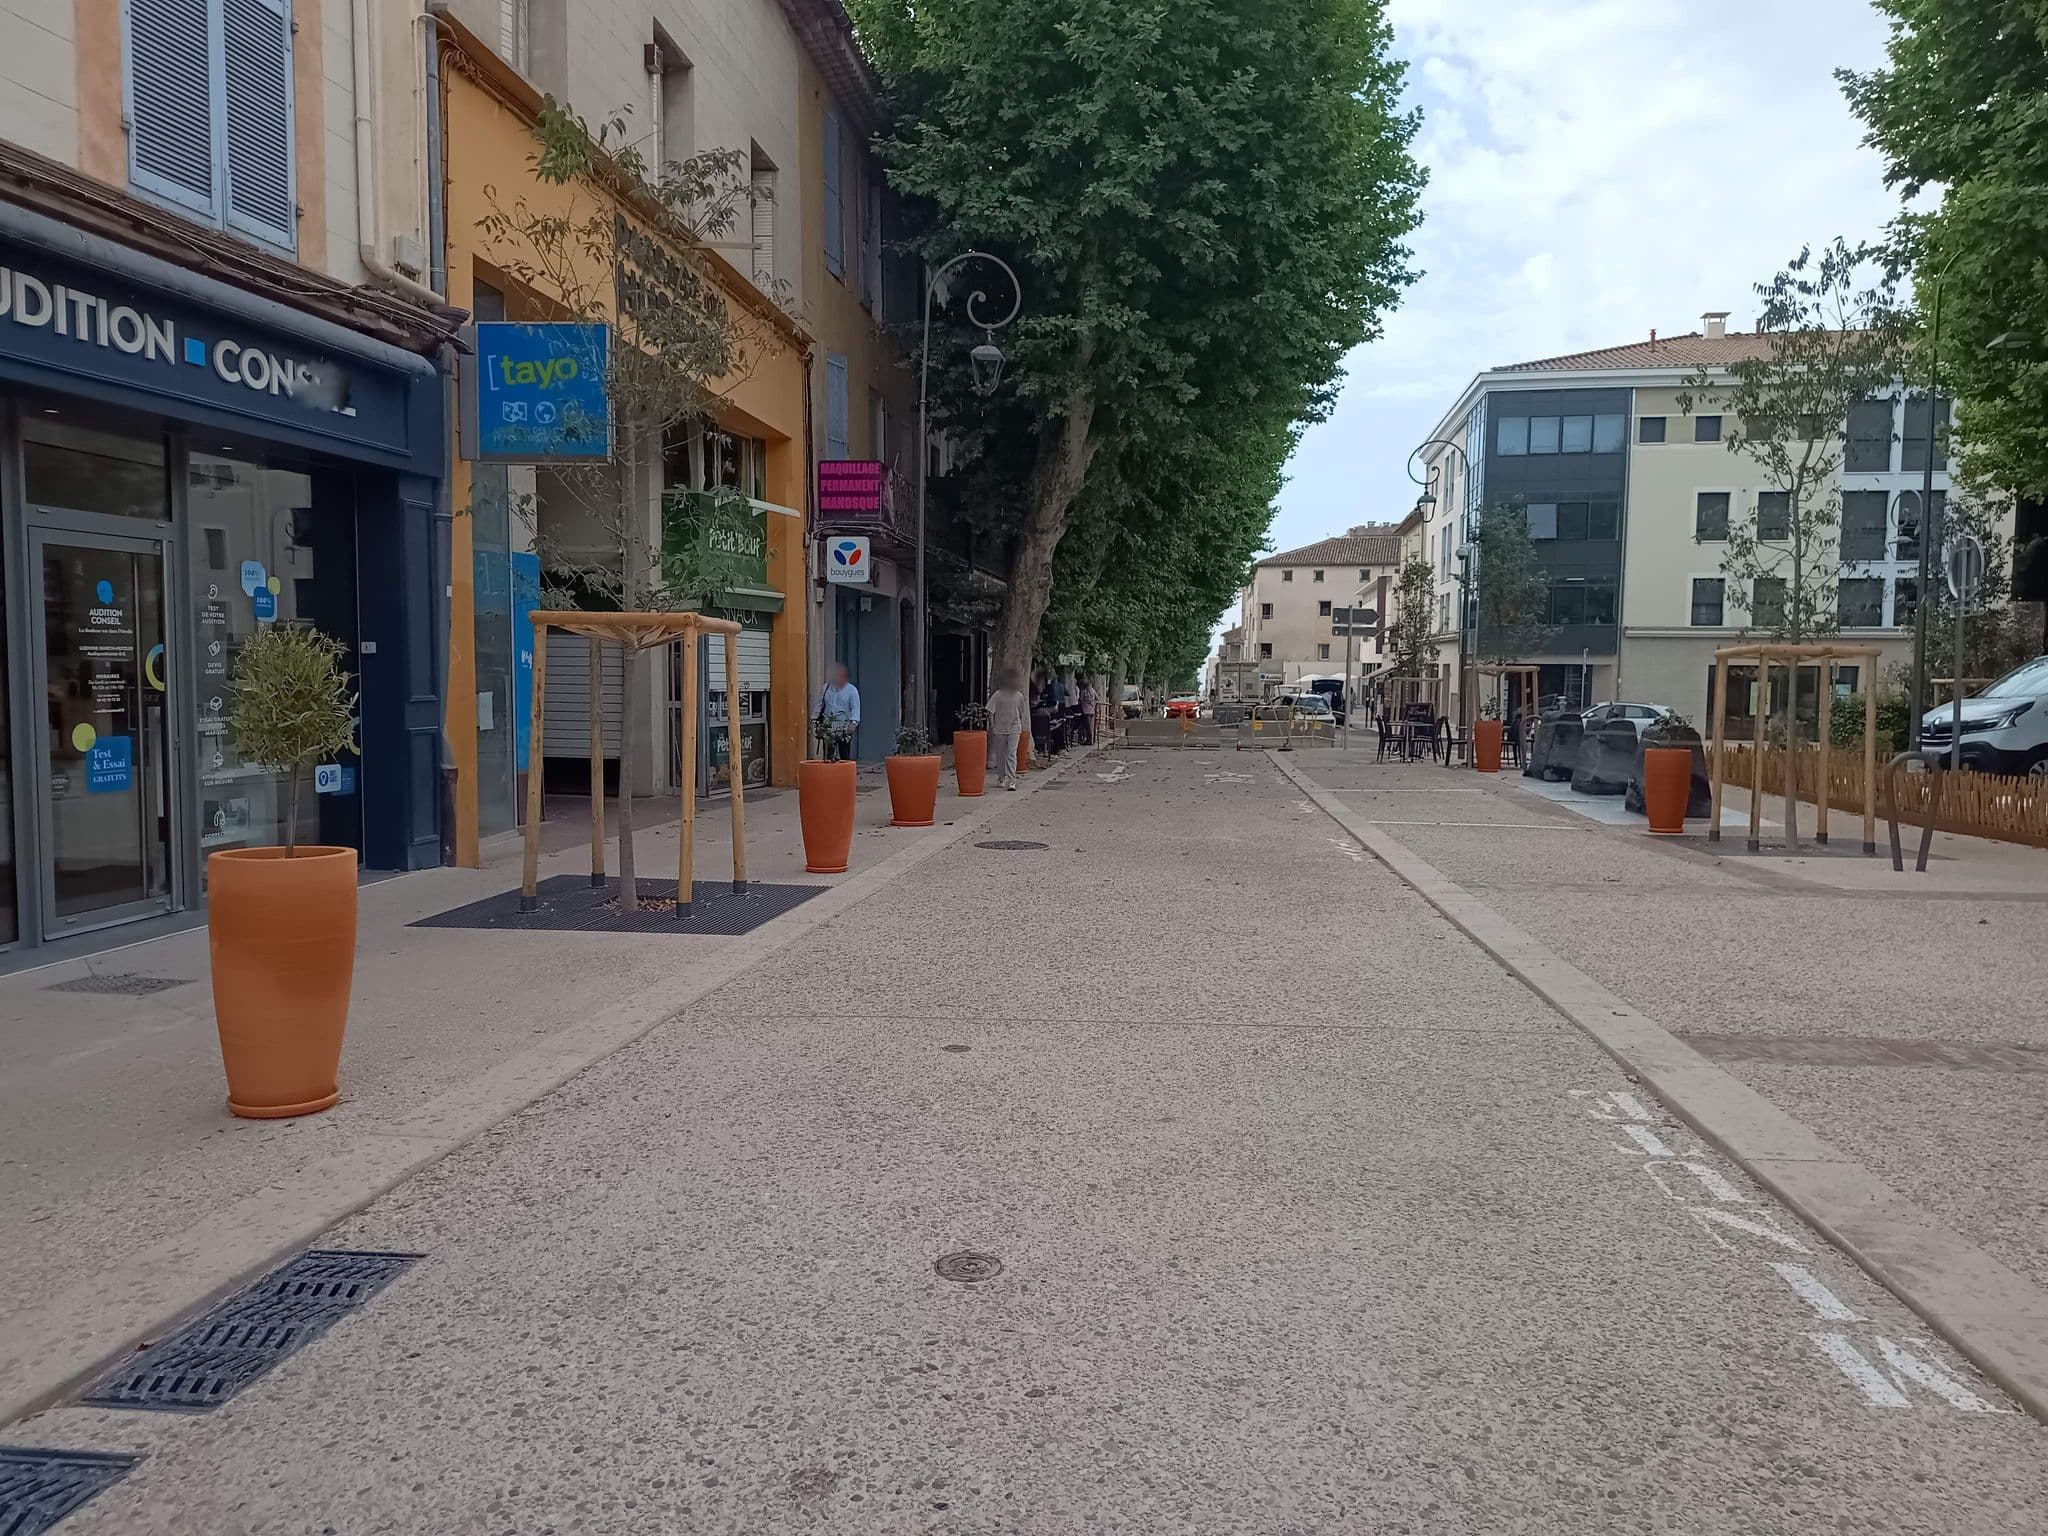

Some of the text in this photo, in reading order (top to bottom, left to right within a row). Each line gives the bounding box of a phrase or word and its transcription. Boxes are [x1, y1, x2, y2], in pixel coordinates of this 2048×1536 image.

[500, 354, 578, 391] tayo
[820, 462, 880, 475] MAQUILLAGE
[820, 480, 880, 492] PERMANENT
[820, 496, 880, 510] MANOSQUE
[830, 567, 865, 578] bouygues
[89, 607, 123, 618] AUDITION
[90, 616, 122, 626] CONSEIL
[92, 749, 112, 759] Test
[103, 758, 126, 769] Essai
[93, 773, 127, 783] GRATUITS
